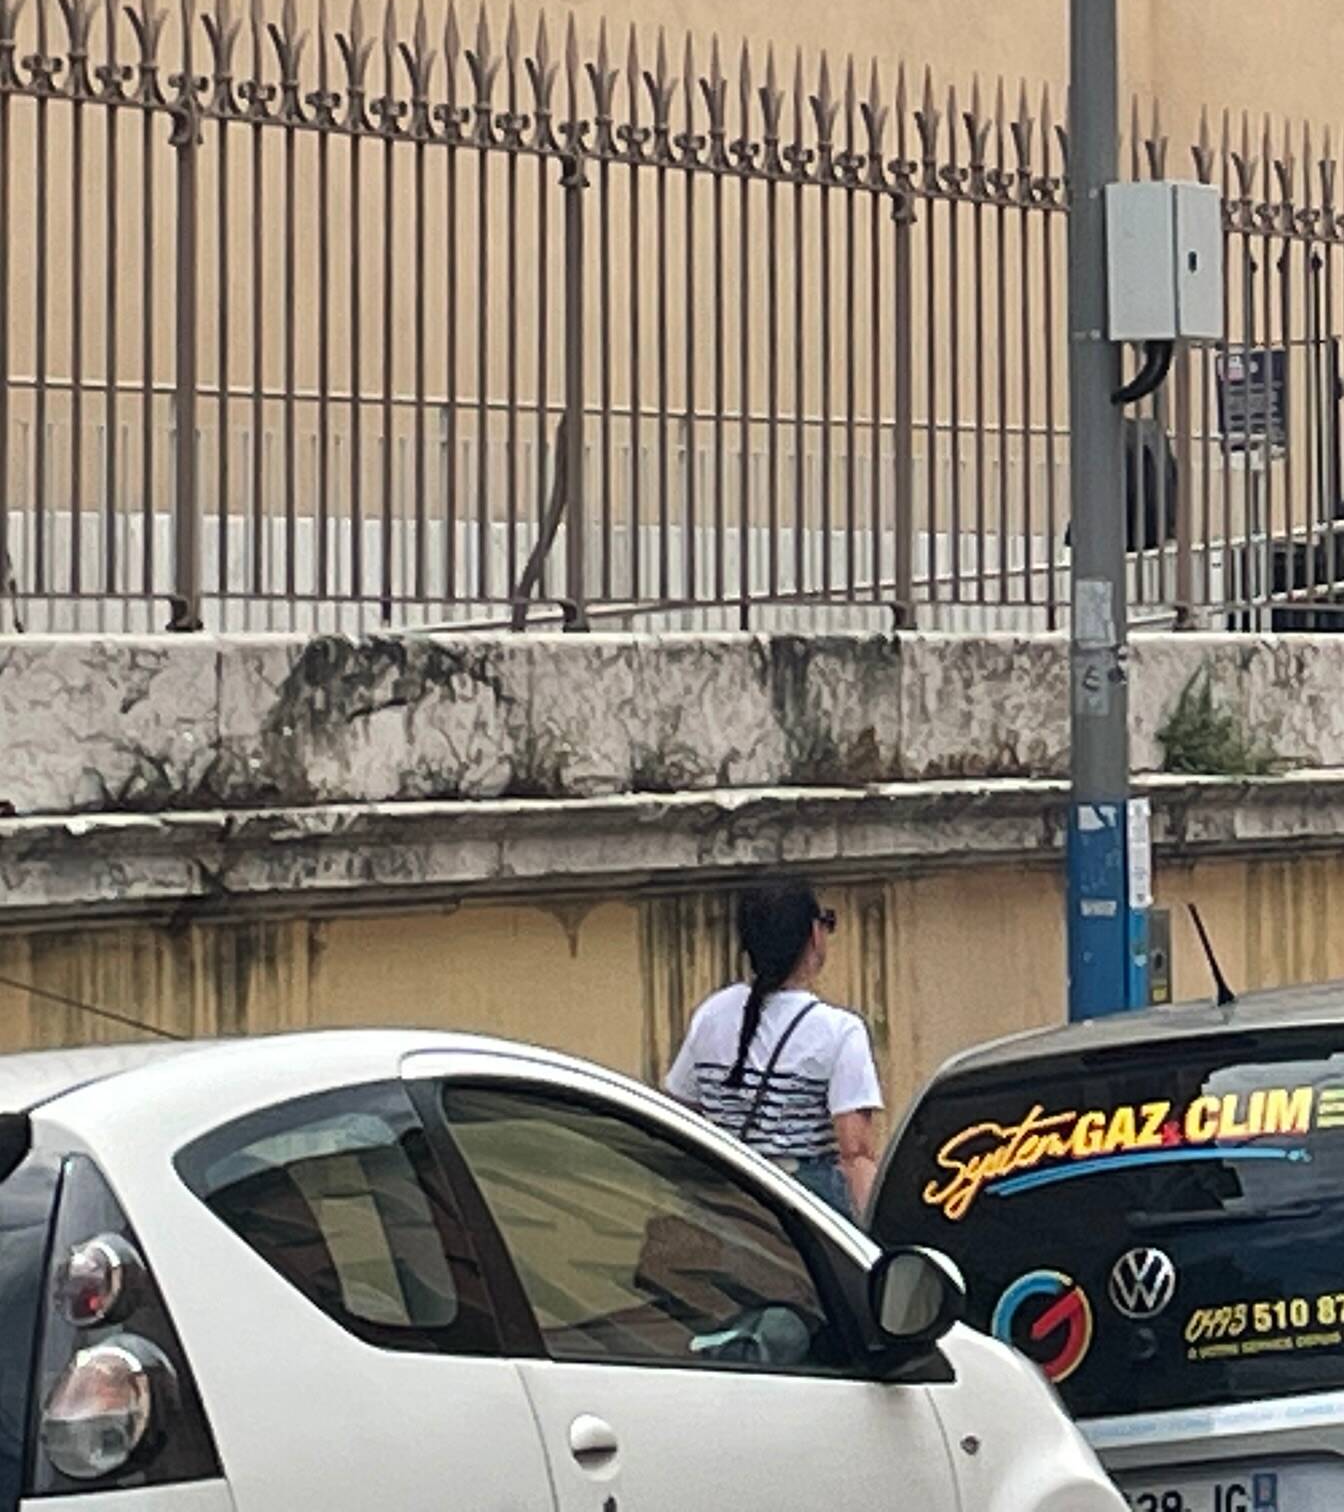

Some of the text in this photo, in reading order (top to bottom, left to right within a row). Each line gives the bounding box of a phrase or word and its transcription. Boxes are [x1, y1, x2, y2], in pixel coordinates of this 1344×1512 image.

[1071, 1100, 1171, 1159] GAZ
[1185, 1085, 1313, 1142] CLIM
[1253, 1298, 1310, 1333] 510
